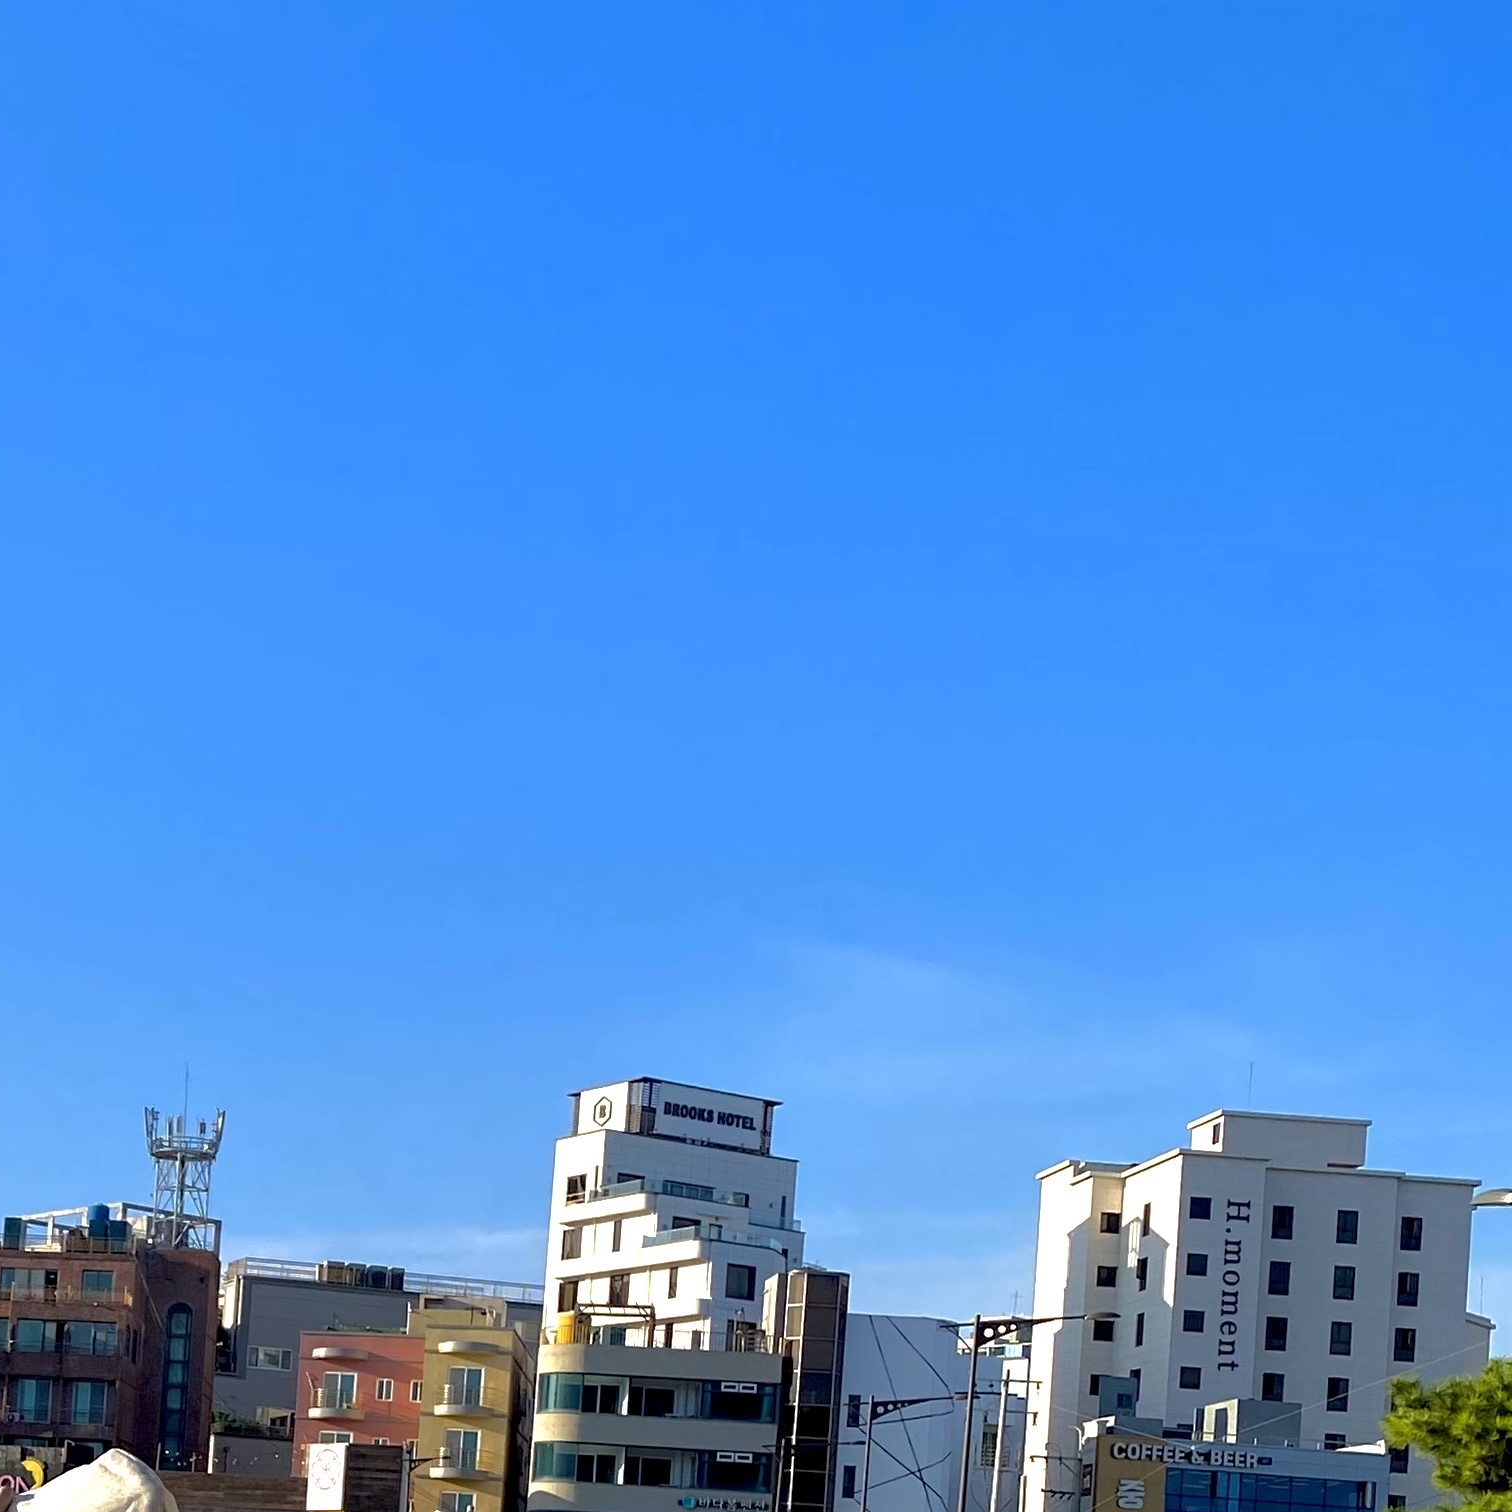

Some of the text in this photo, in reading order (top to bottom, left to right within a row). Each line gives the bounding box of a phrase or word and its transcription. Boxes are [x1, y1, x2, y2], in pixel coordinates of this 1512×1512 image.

[663, 1101, 757, 1131] BROOKS HOTEL
[1217, 1198, 1252, 1372] H.moment
[1113, 1441, 1186, 1463] COFFEE
[1210, 1450, 1259, 1468] BEER
